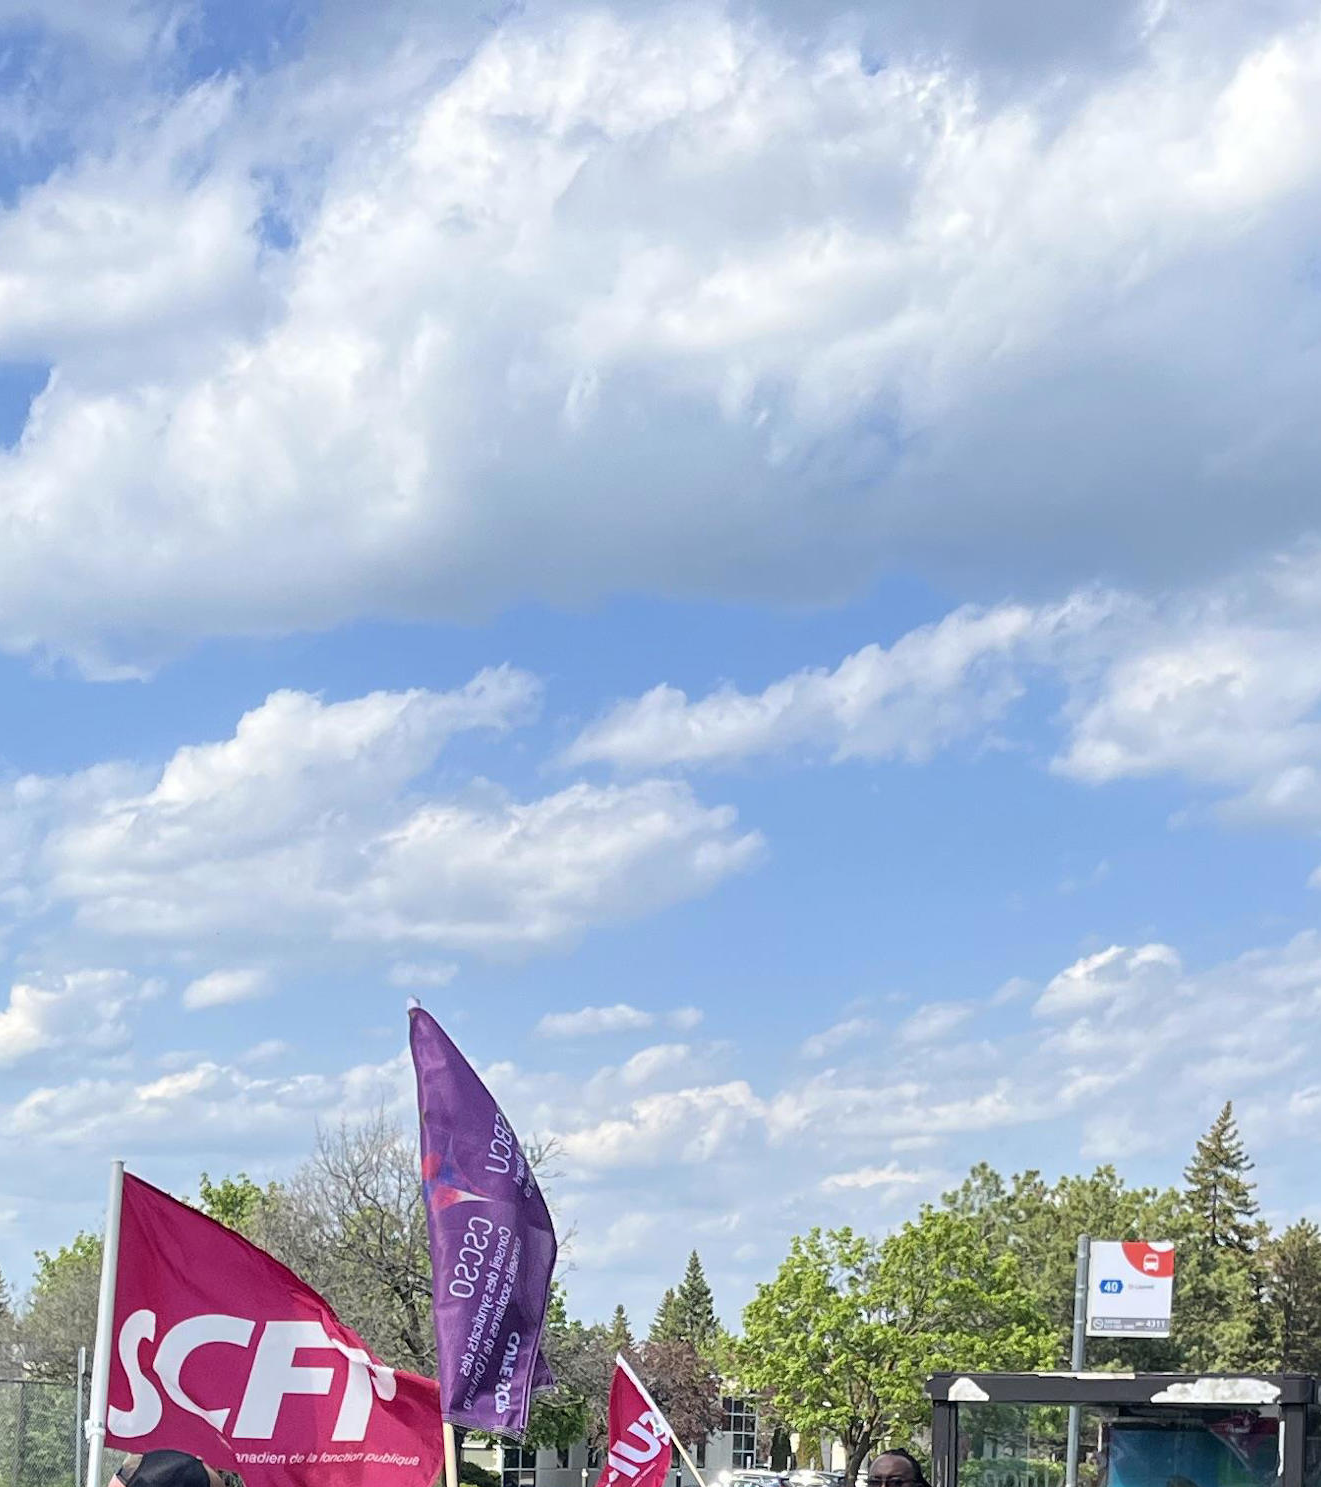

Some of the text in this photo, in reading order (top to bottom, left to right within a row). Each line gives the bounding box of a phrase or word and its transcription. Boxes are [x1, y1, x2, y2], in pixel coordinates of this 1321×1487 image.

[1104, 1281, 1118, 1293] 40
[234, 1451, 421, 1467] anadien de la fonction publique
